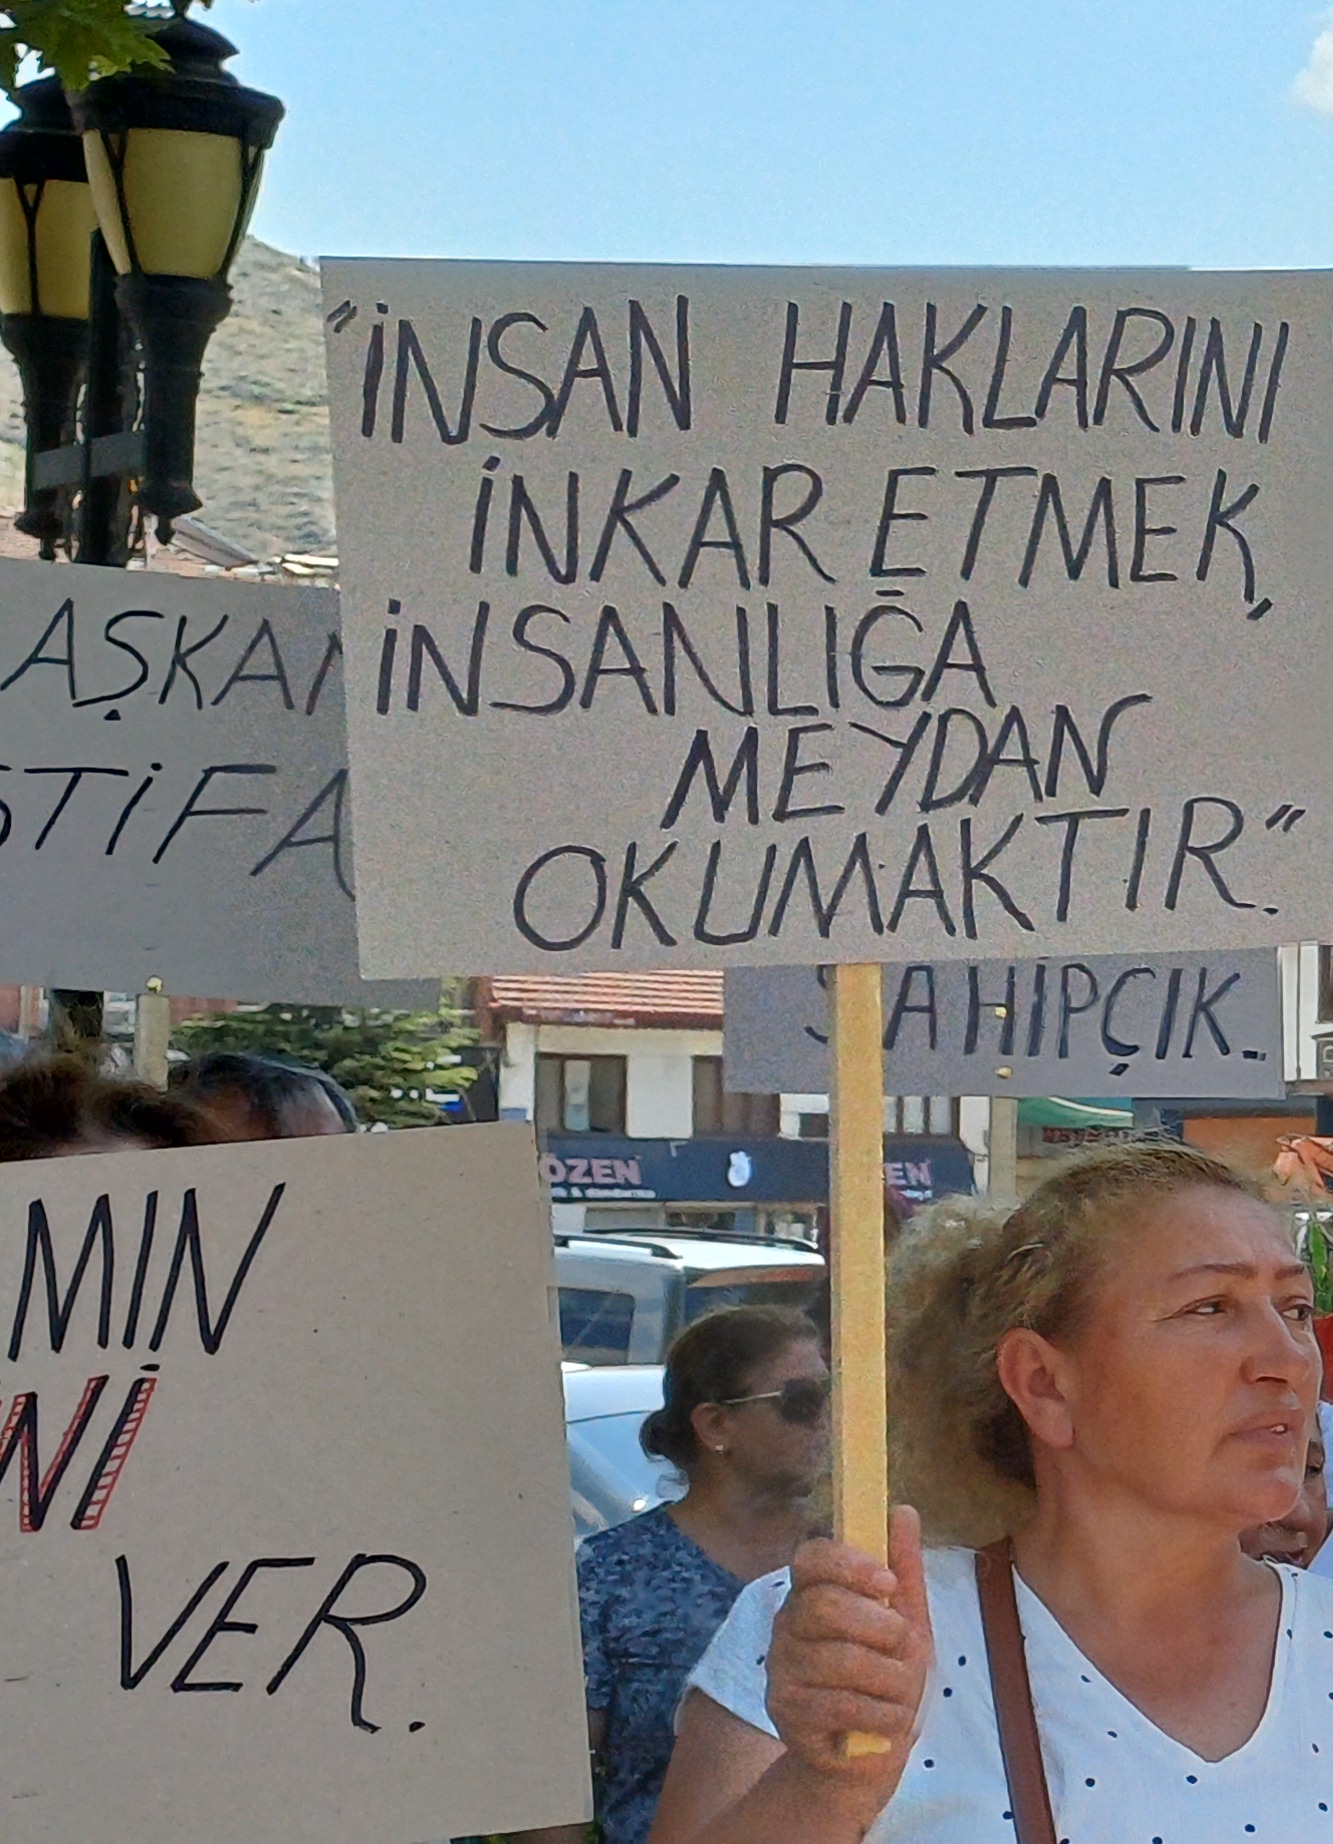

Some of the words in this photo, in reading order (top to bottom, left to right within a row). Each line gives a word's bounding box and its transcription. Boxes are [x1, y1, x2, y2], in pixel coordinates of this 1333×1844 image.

[326, 294, 692, 446] "İNSAN
[774, 301, 1290, 444] HAKLARINI
[469, 455, 837, 591] İNKAR
[869, 466, 1273, 622] ETMEK,
[376, 589, 998, 718] İNSANLIĞA
[660, 692, 1153, 830] MEYDAN
[7, 1181, 287, 1363] MIN
[114, 1552, 427, 1735] VER.
